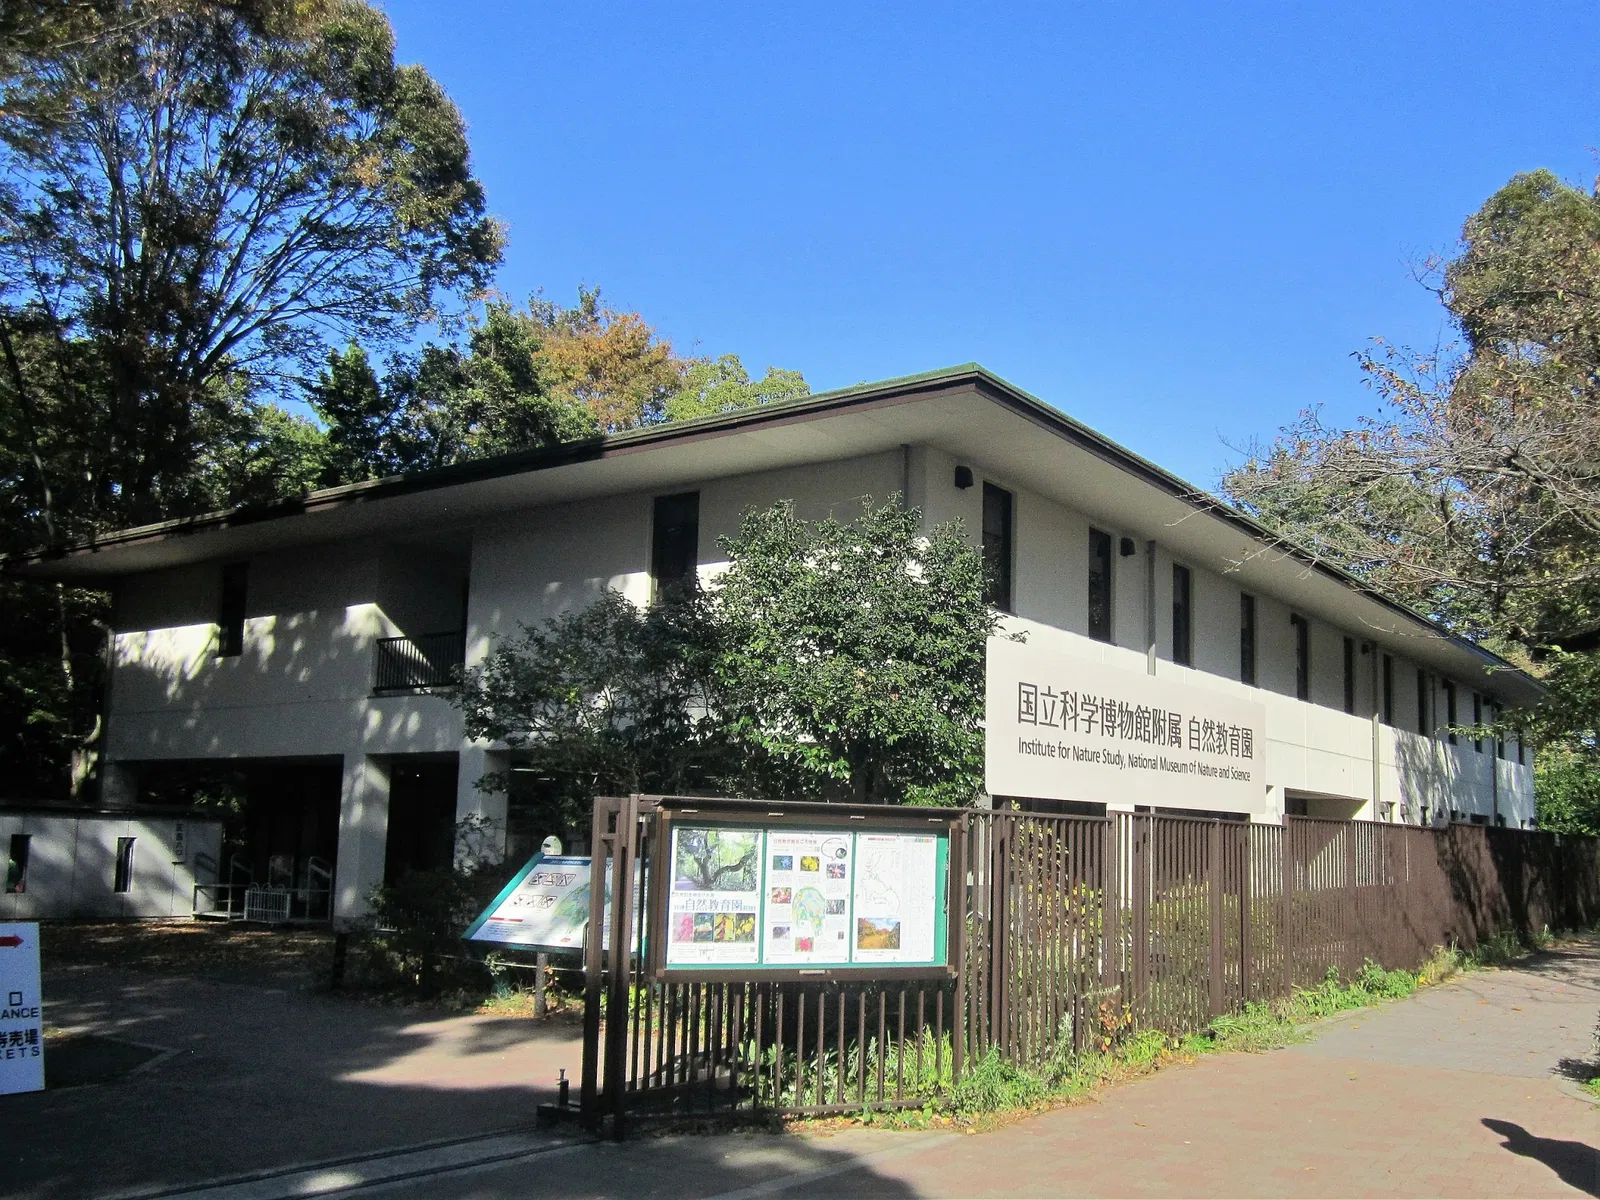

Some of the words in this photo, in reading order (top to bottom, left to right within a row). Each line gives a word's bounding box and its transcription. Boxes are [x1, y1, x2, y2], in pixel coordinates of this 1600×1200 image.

[1018, 682, 1182, 748] 国立科学博物館附属
[1188, 716, 1253, 760] 自然教育園
[1018, 737, 1056, 758] Institute
[1058, 741, 1071, 760] for
[1073, 746, 1101, 763] Nature
[1102, 748, 1126, 770] Study,
[1128, 753, 1159, 770] National
[1160, 756, 1188, 774] Museum
[1189, 760, 1197, 775] of
[1198, 762, 1218, 778] Nature
[1219, 765, 1230, 780] and
[1231, 766, 1251, 782] Science
[685, 898, 743, 912] 自然教育園
[0, 1007, 39, 1019] ANCE
[0, 1046, 40, 1060] ETS
